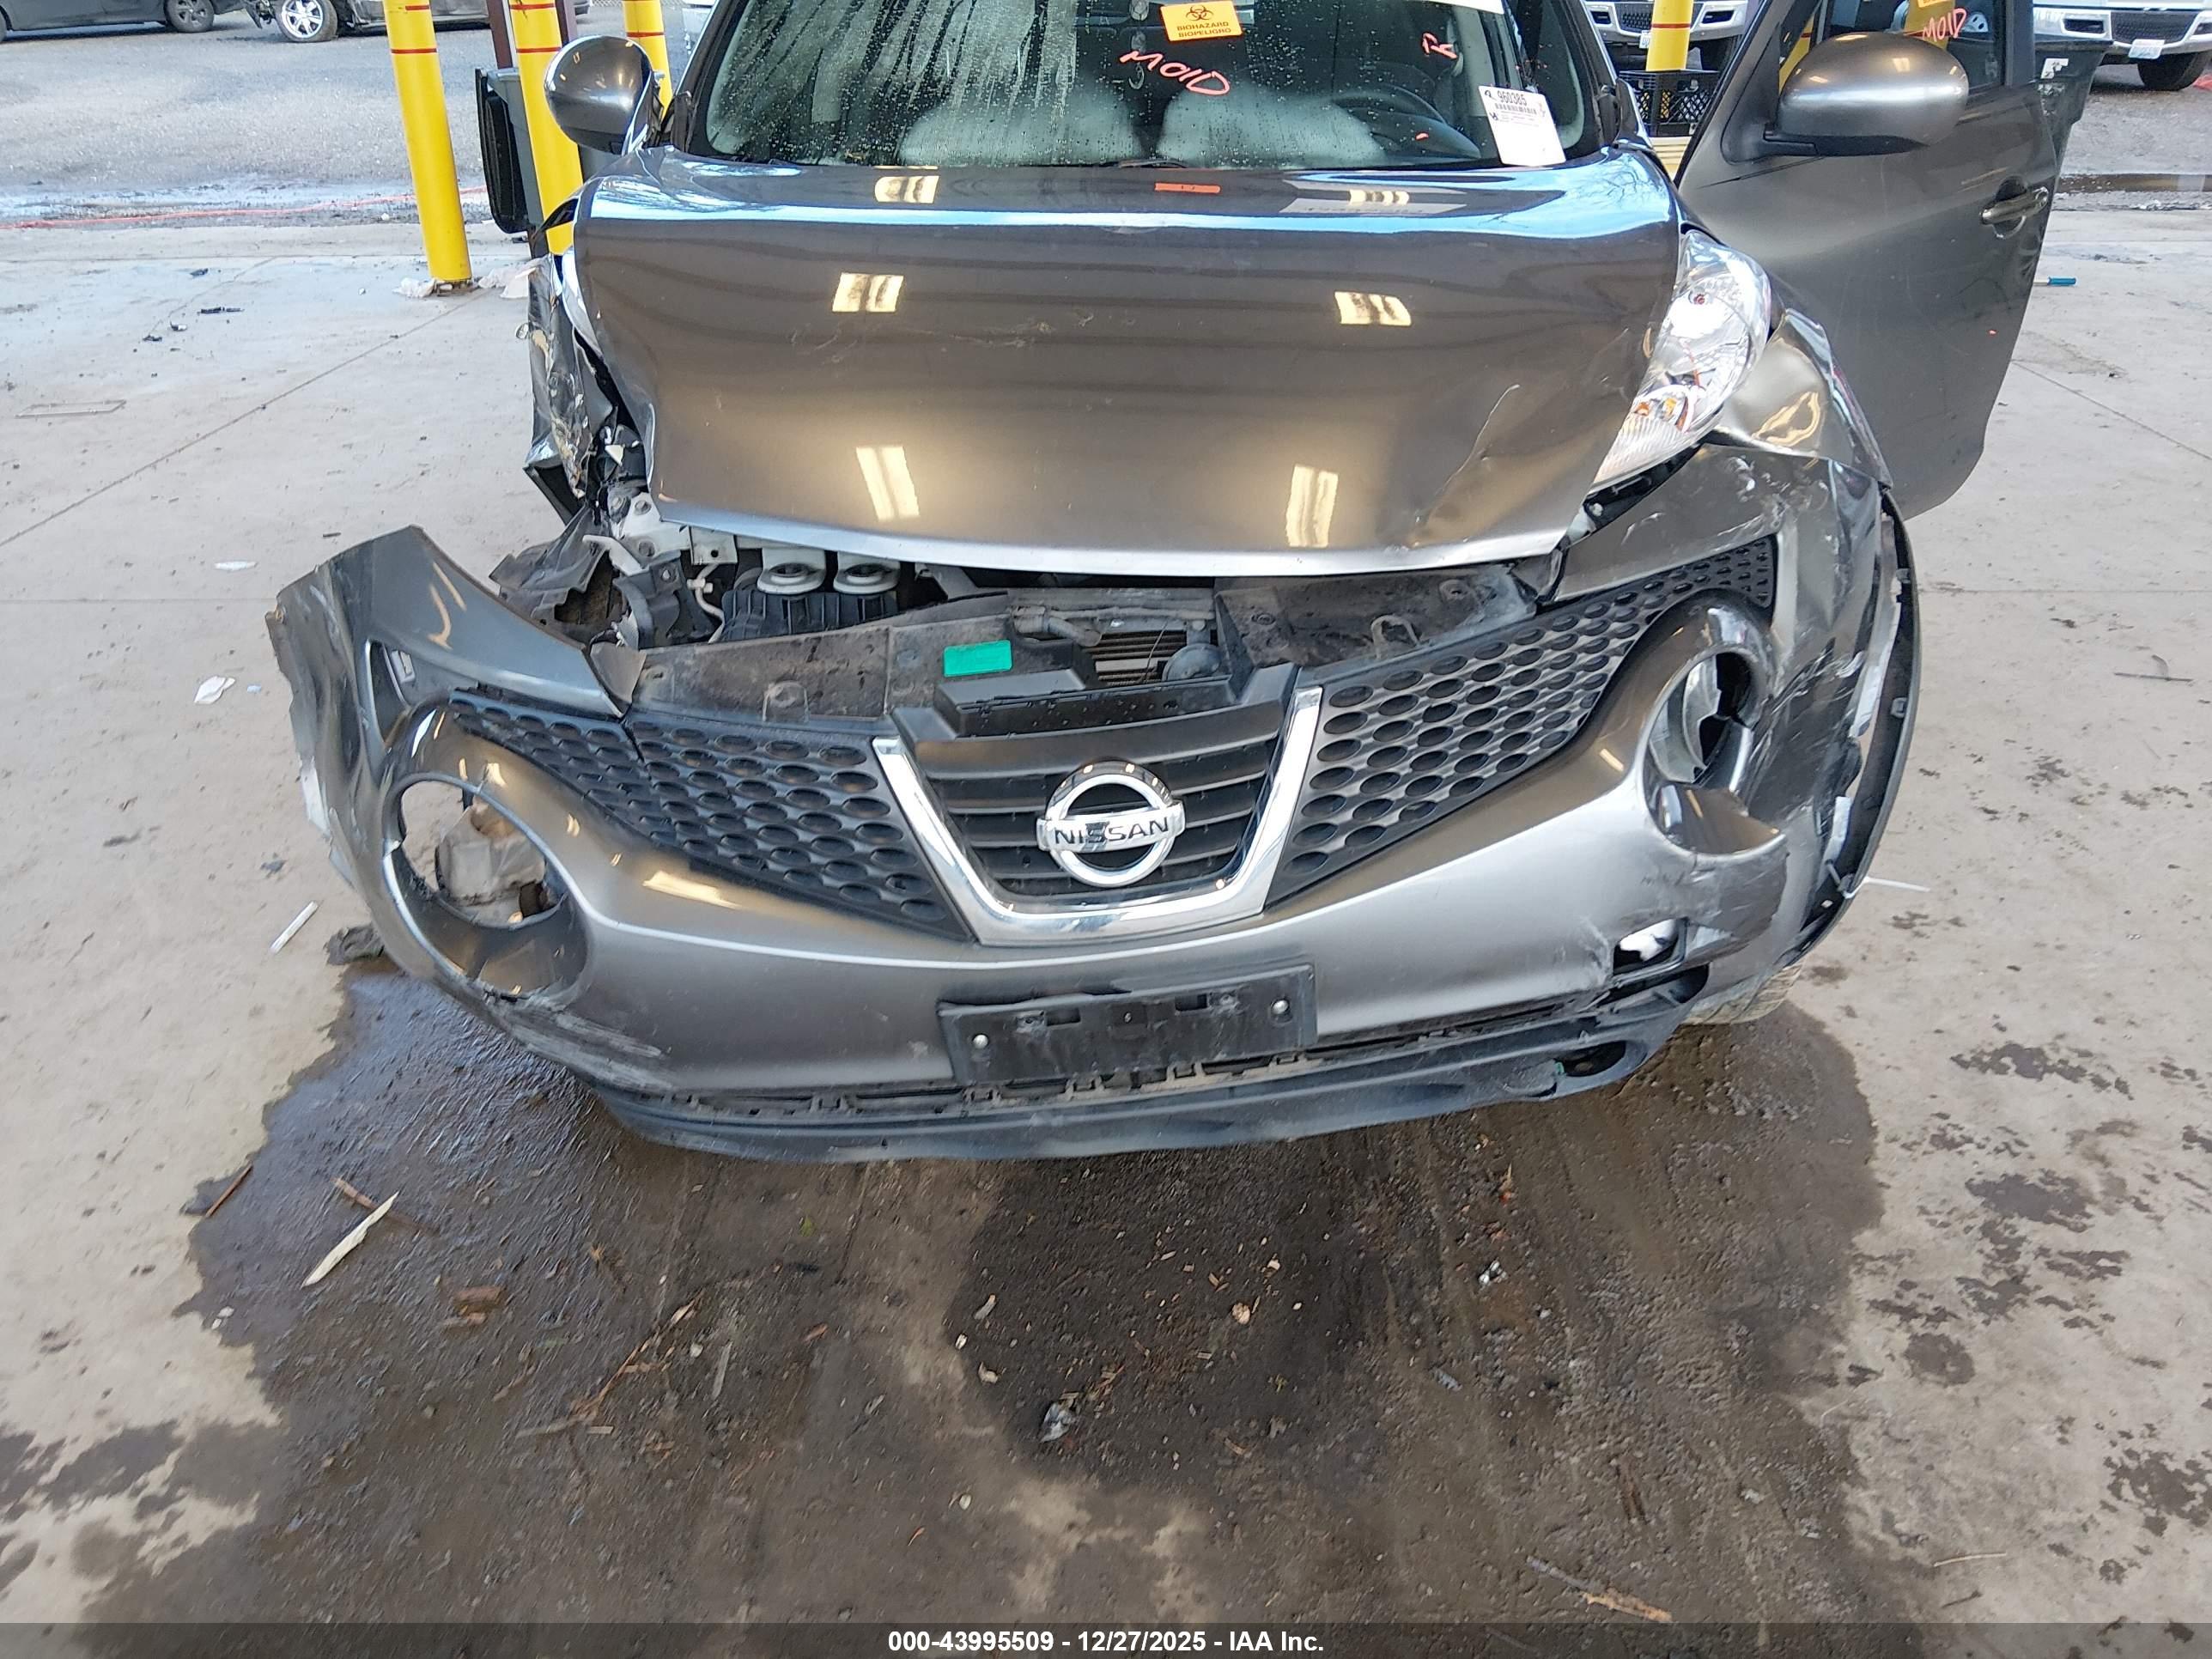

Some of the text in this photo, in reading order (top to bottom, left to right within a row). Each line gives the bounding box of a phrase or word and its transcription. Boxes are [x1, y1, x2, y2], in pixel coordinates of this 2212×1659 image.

[1176, 21, 1229, 31] BIOHAZARD
[1178, 27, 1231, 38] BIOPELIGRO
[1054, 817, 1170, 844] NISSAN
